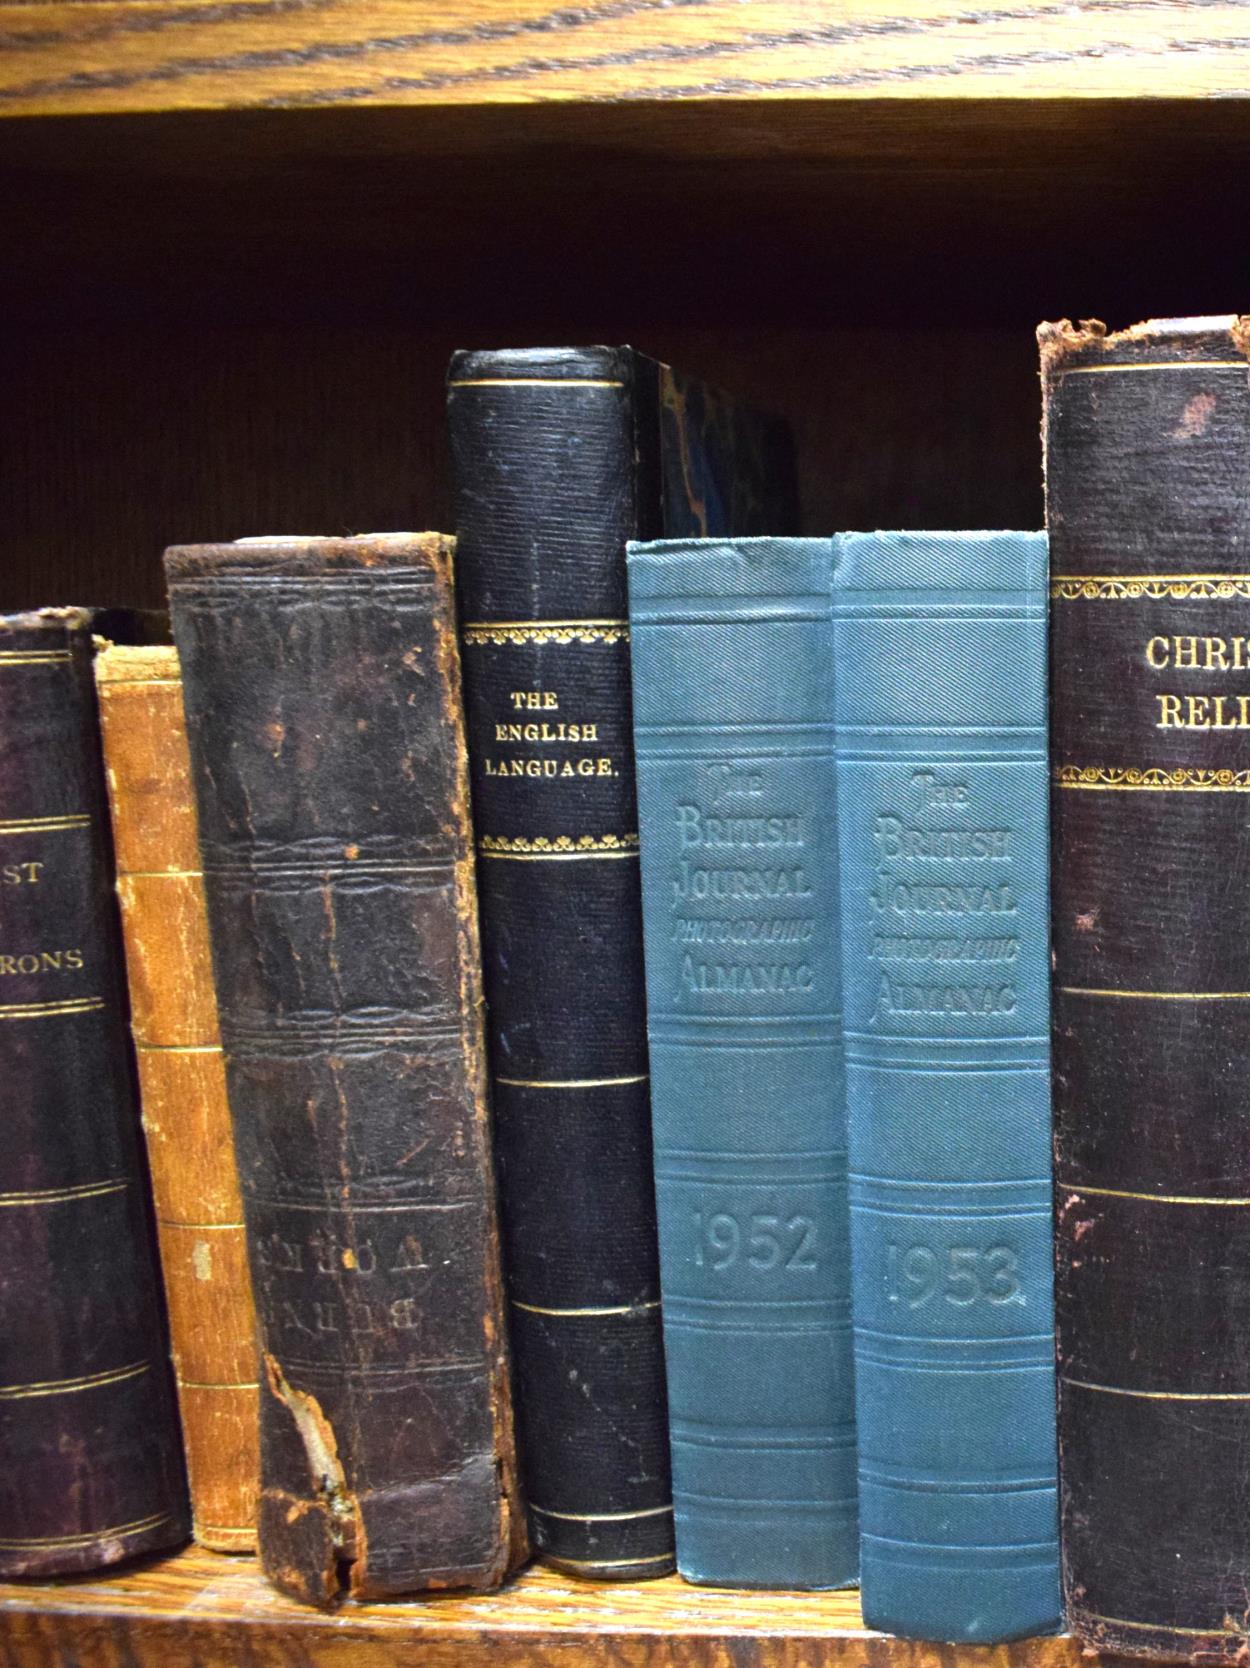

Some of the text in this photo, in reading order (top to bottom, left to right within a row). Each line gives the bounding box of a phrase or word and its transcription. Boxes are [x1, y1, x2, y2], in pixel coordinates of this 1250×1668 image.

[510, 691, 559, 710] THE
[494, 723, 599, 742] ENGLISH
[484, 757, 620, 778] LANGUAGE.
[694, 1211, 818, 1271] 1952
[888, 1244, 1021, 1309] 1953
